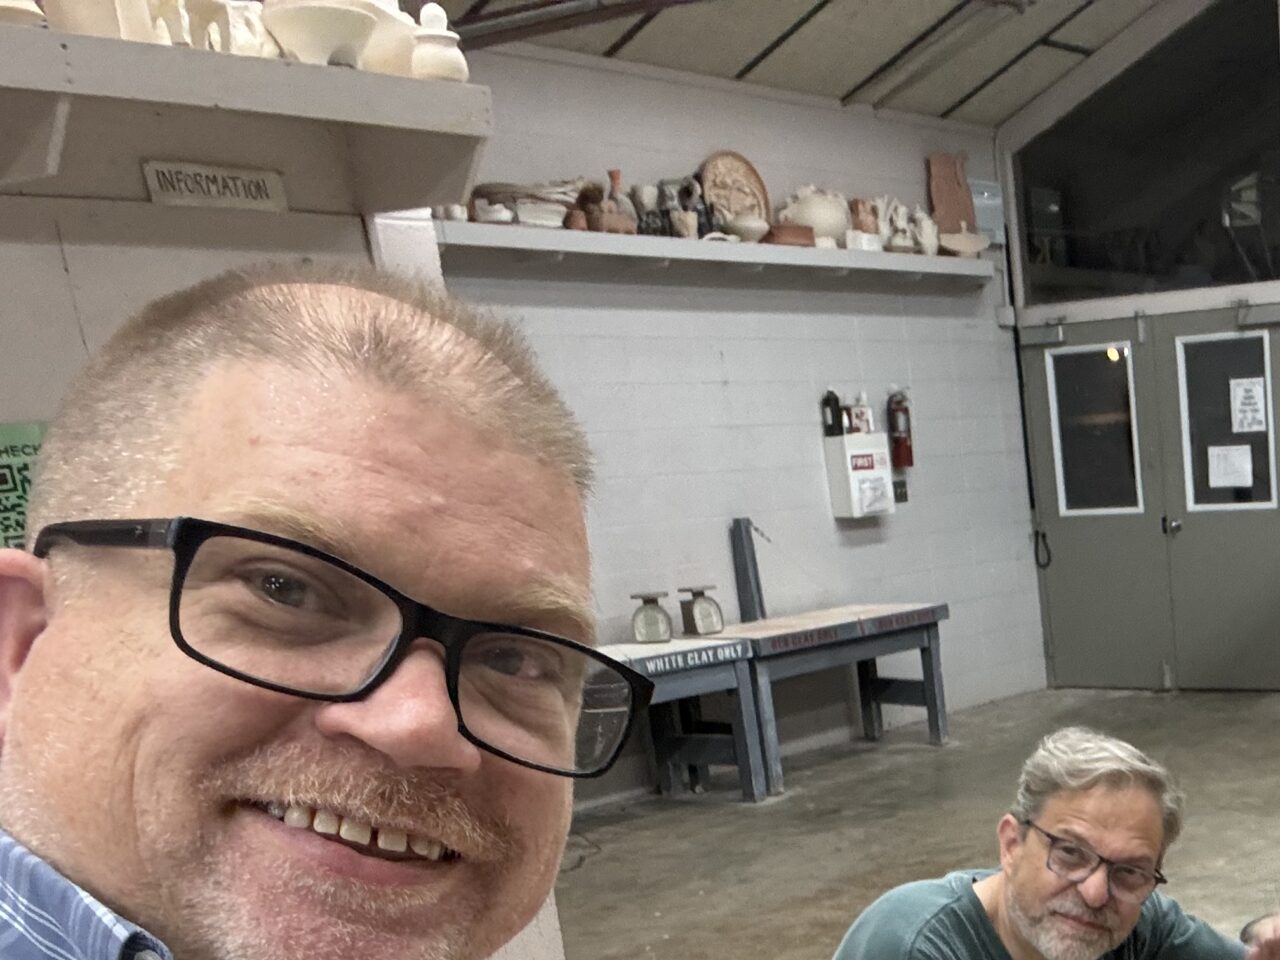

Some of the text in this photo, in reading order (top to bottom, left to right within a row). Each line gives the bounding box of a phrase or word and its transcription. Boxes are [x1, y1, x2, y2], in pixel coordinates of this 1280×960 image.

[155, 168, 270, 200] INFORMATION
[646, 643, 742, 673] WHITE CLAY ONLY
